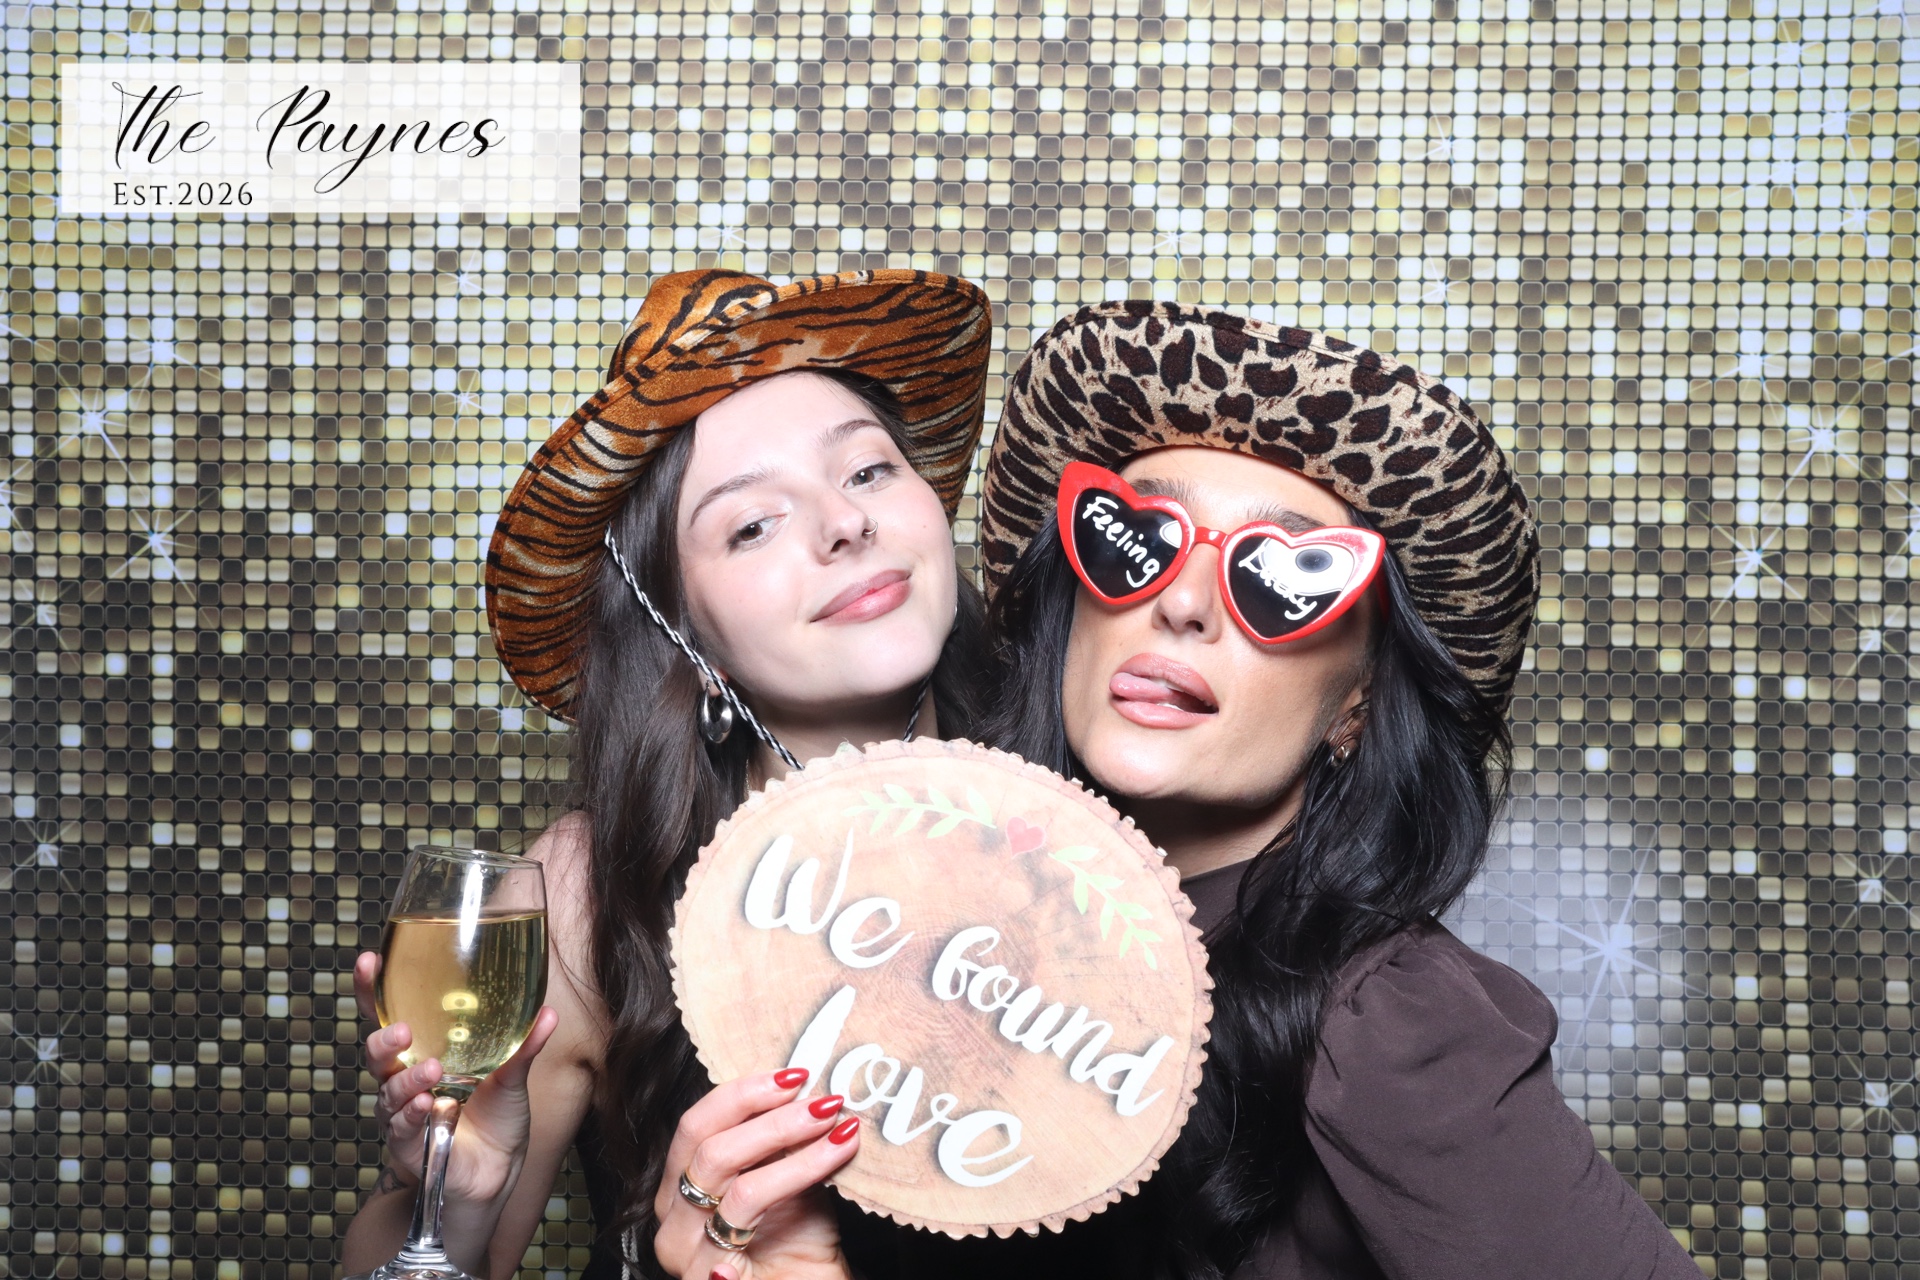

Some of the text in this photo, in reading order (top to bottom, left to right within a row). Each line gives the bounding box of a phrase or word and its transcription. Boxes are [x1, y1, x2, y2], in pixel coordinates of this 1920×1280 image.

[1082, 496, 1160, 588] Feeling
[744, 827, 1174, 1117] We found
[785, 983, 1034, 1188] love
